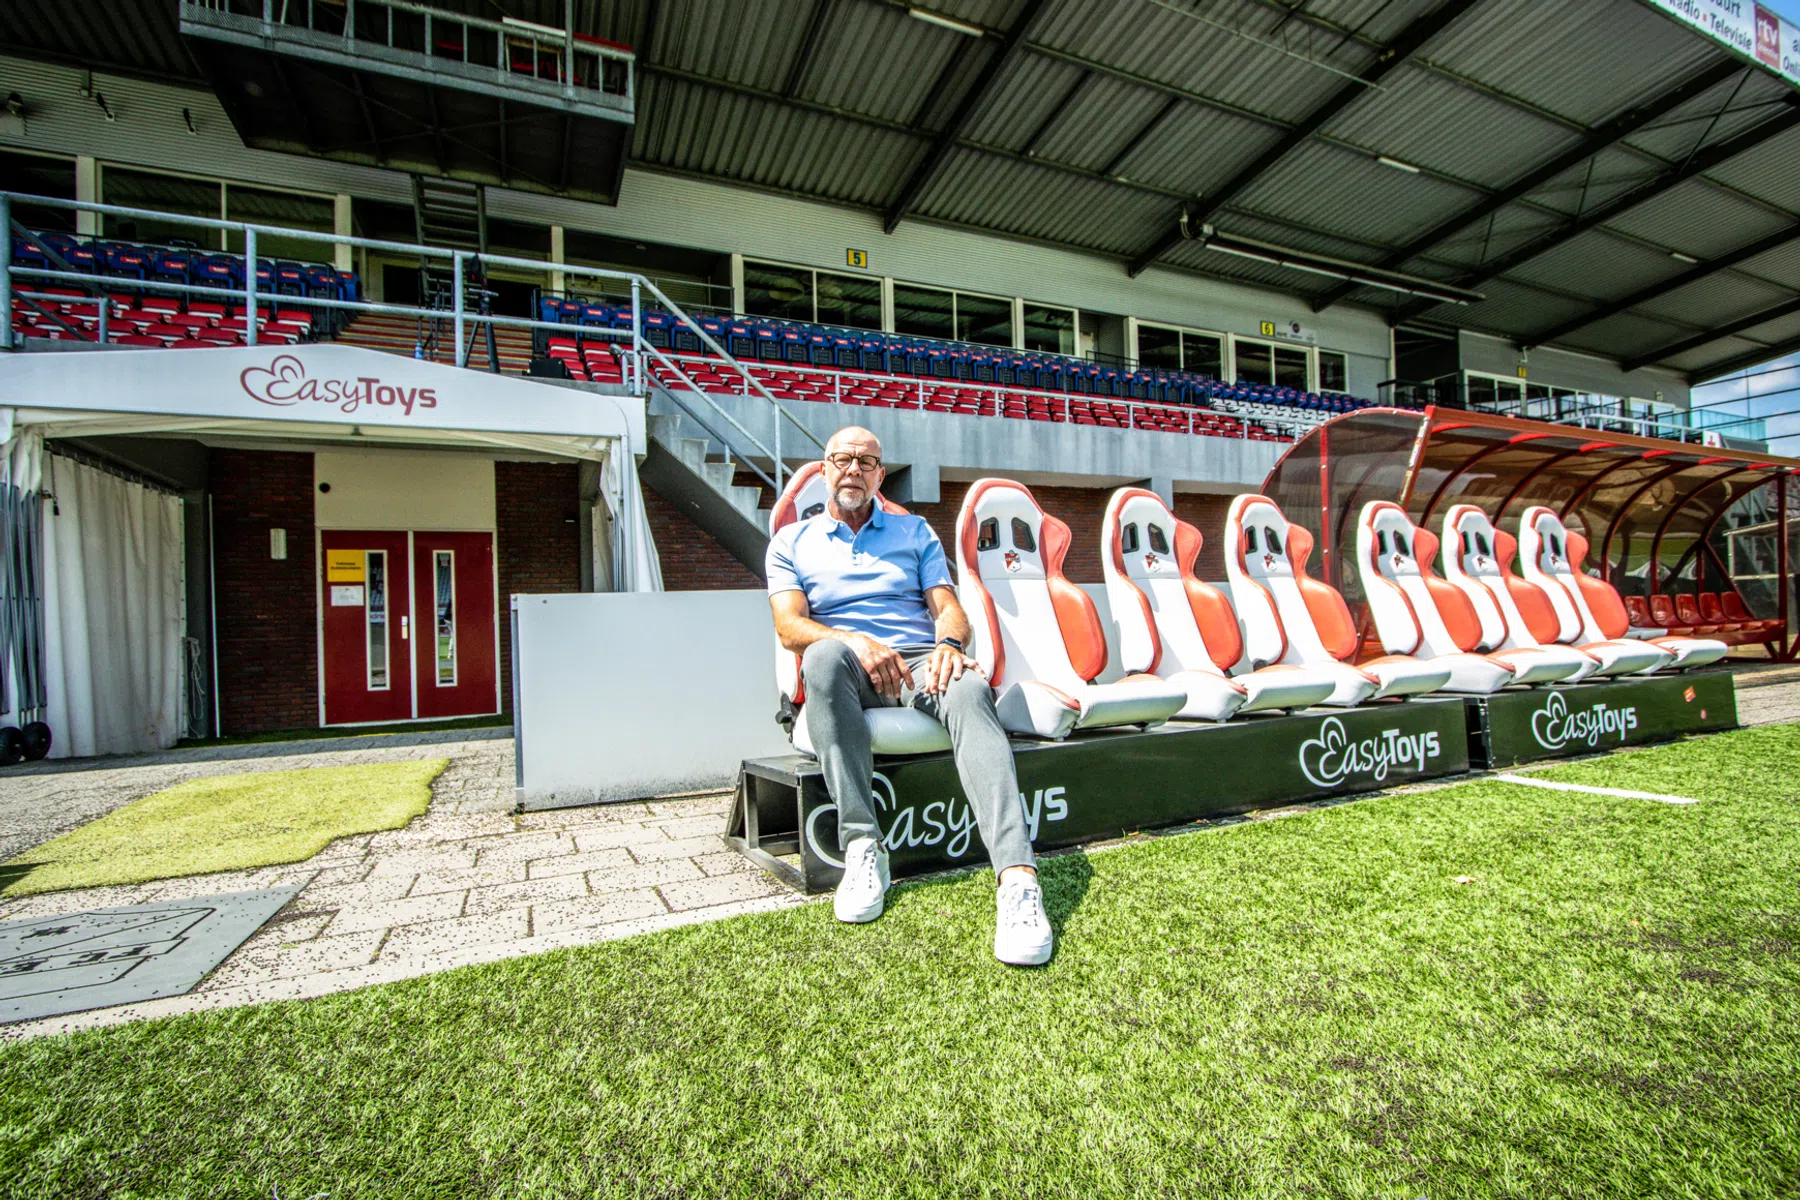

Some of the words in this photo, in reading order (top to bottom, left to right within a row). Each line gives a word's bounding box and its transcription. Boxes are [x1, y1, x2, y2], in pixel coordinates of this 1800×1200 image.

[1710, 0, 1742, 17] uurt
[1710, 12, 1752, 50] Televisie
[1757, 18, 1778, 46] rtv
[853, 252, 861, 265] 5
[257, 361, 437, 416] EasyToys
[1540, 698, 1637, 748] EasyToys
[1312, 725, 1440, 782] EasyToys
